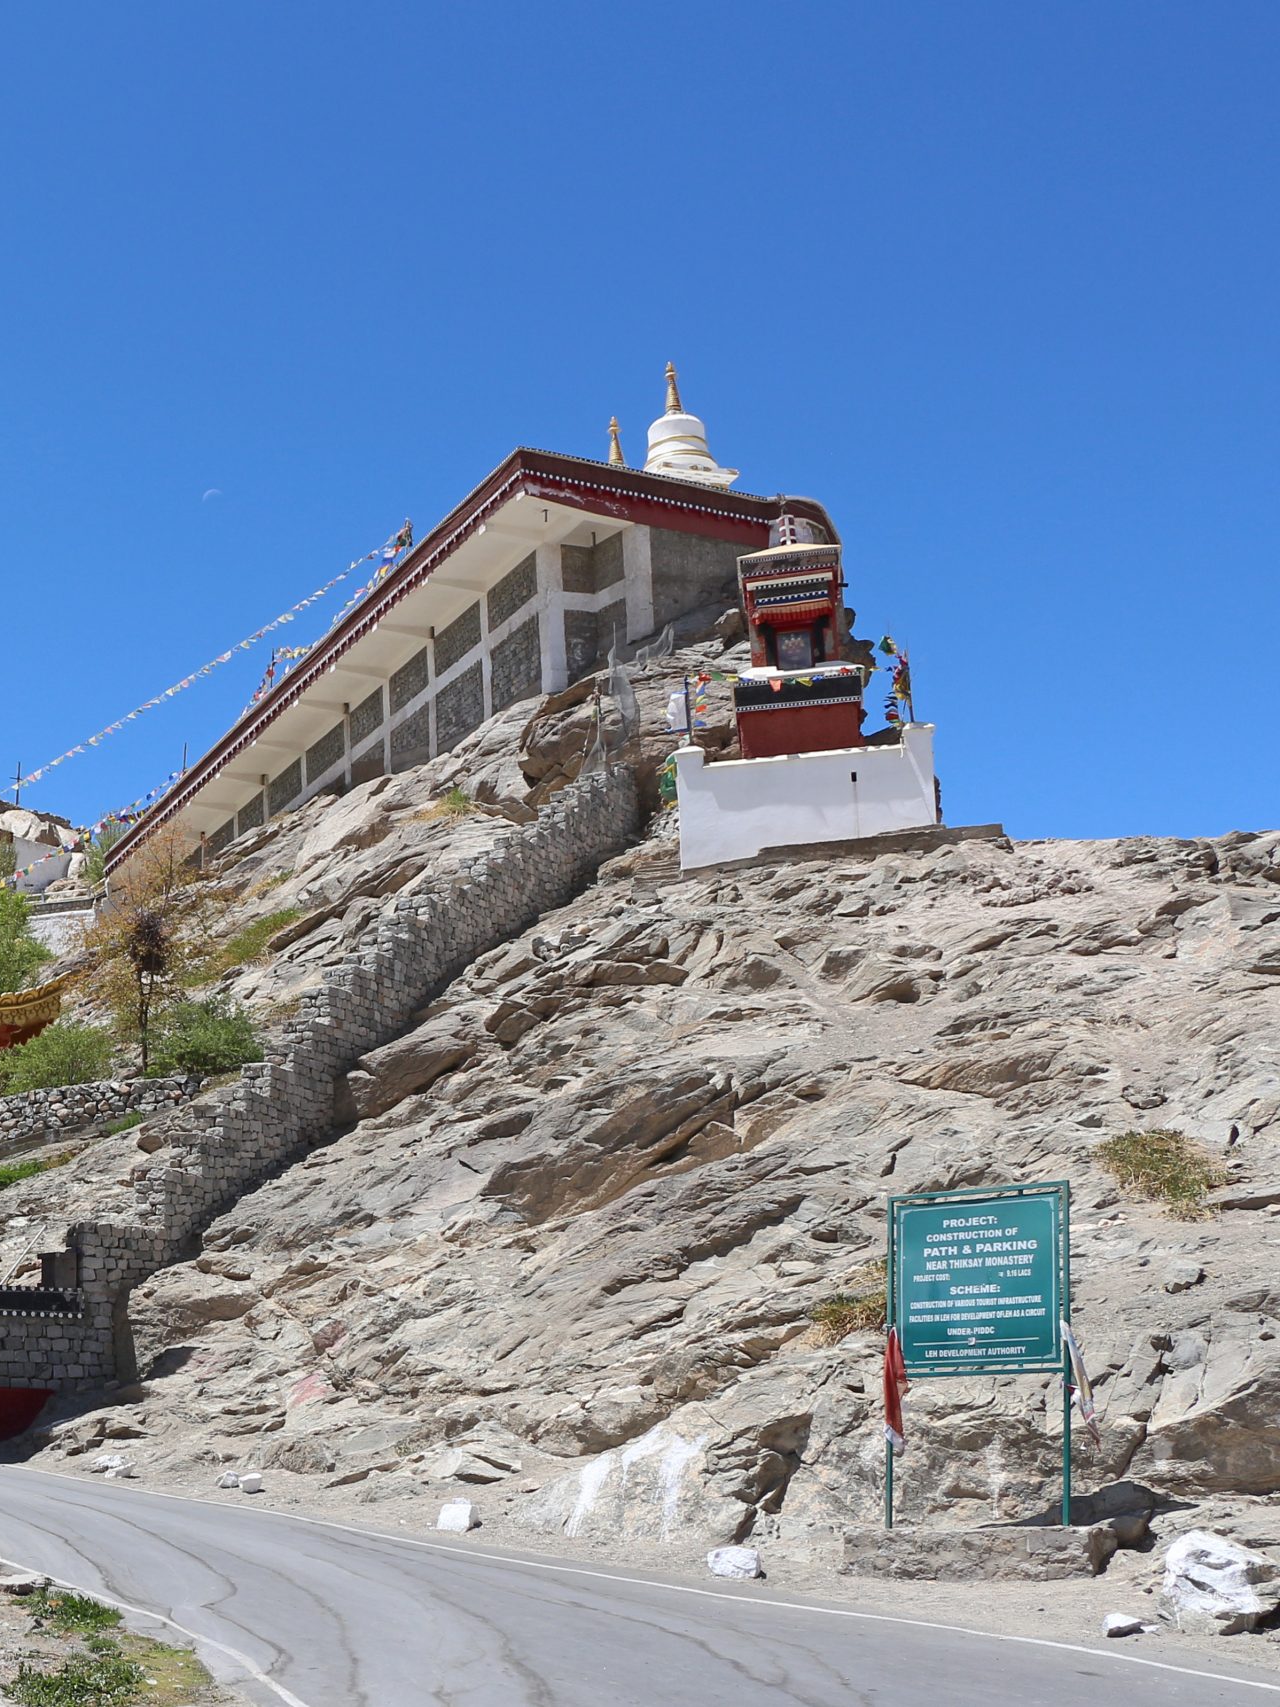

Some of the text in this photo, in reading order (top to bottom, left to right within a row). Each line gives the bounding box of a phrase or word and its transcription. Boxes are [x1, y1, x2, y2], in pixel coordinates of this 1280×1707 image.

[943, 1216, 998, 1228] PROJECT:
[926, 1227, 1018, 1242] CONSTRUCTION OF
[924, 1240, 1038, 1257] PATH & PARKING
[926, 1254, 1034, 1270] NEAR THIKSAY MONASTERY
[913, 1274, 935, 1282] PROJECT
[950, 1284, 1000, 1295] SCHEME:
[910, 1295, 1042, 1310] CONSTRUCTION OF VARIOUS TOURIST INFRASTRUCTURE
[909, 1314, 933, 1323] FACILITIES
[961, 1311, 996, 1320] DEVELOPMENT
[1013, 1309, 1020, 1317] AS
[1025, 1308, 1046, 1316] CIRCUIT
[939, 1348, 986, 1357] DEVELOPMENT
[988, 1346, 1026, 1355] AUTHORITY
